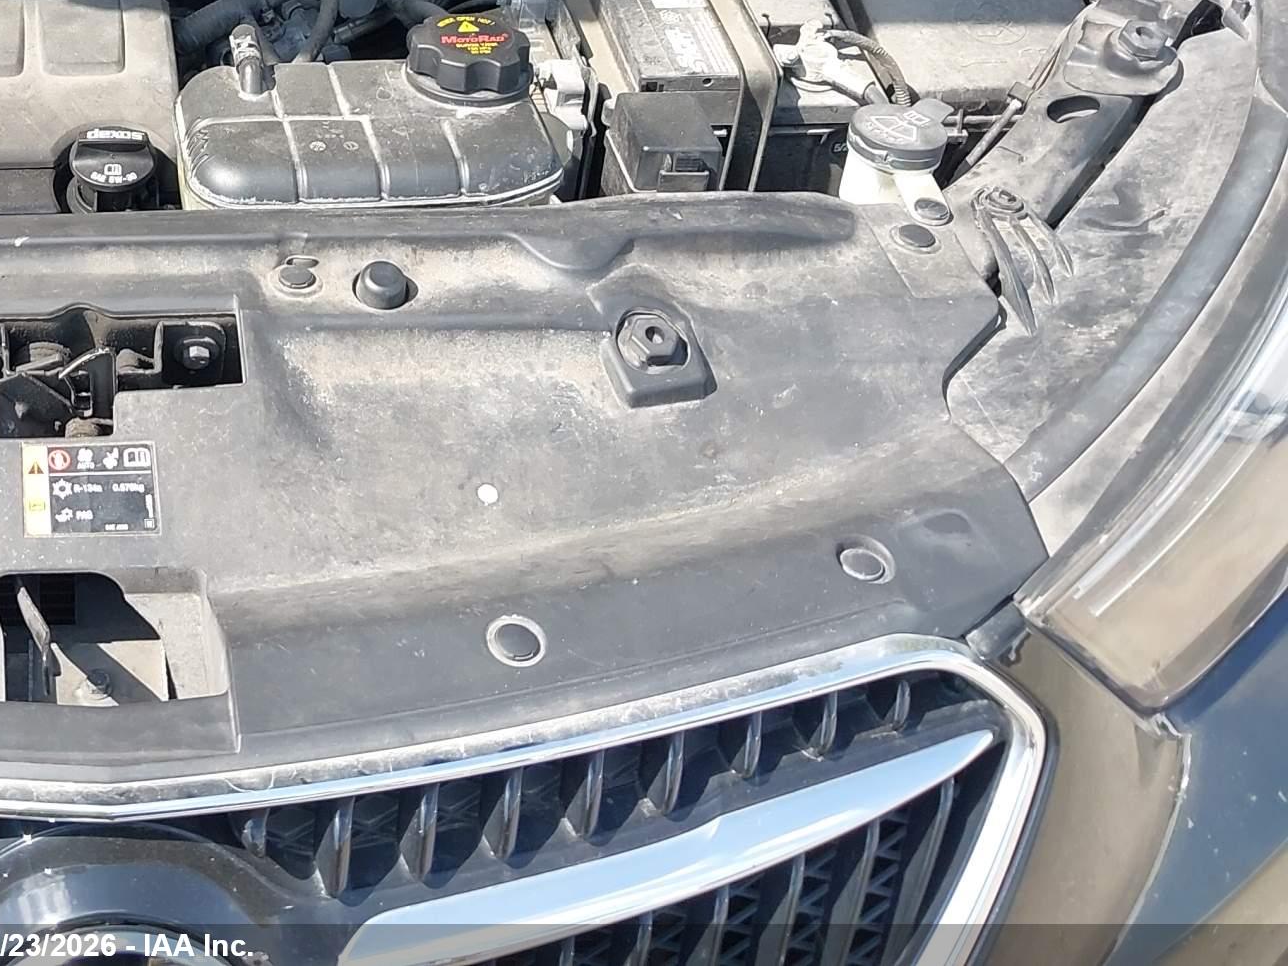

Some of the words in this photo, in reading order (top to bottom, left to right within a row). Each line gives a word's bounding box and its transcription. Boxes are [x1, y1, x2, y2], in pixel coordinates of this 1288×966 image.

[86, 128, 145, 141] dexos
[90, 171, 107, 183] SAE
[77, 461, 95, 470] AUTO
